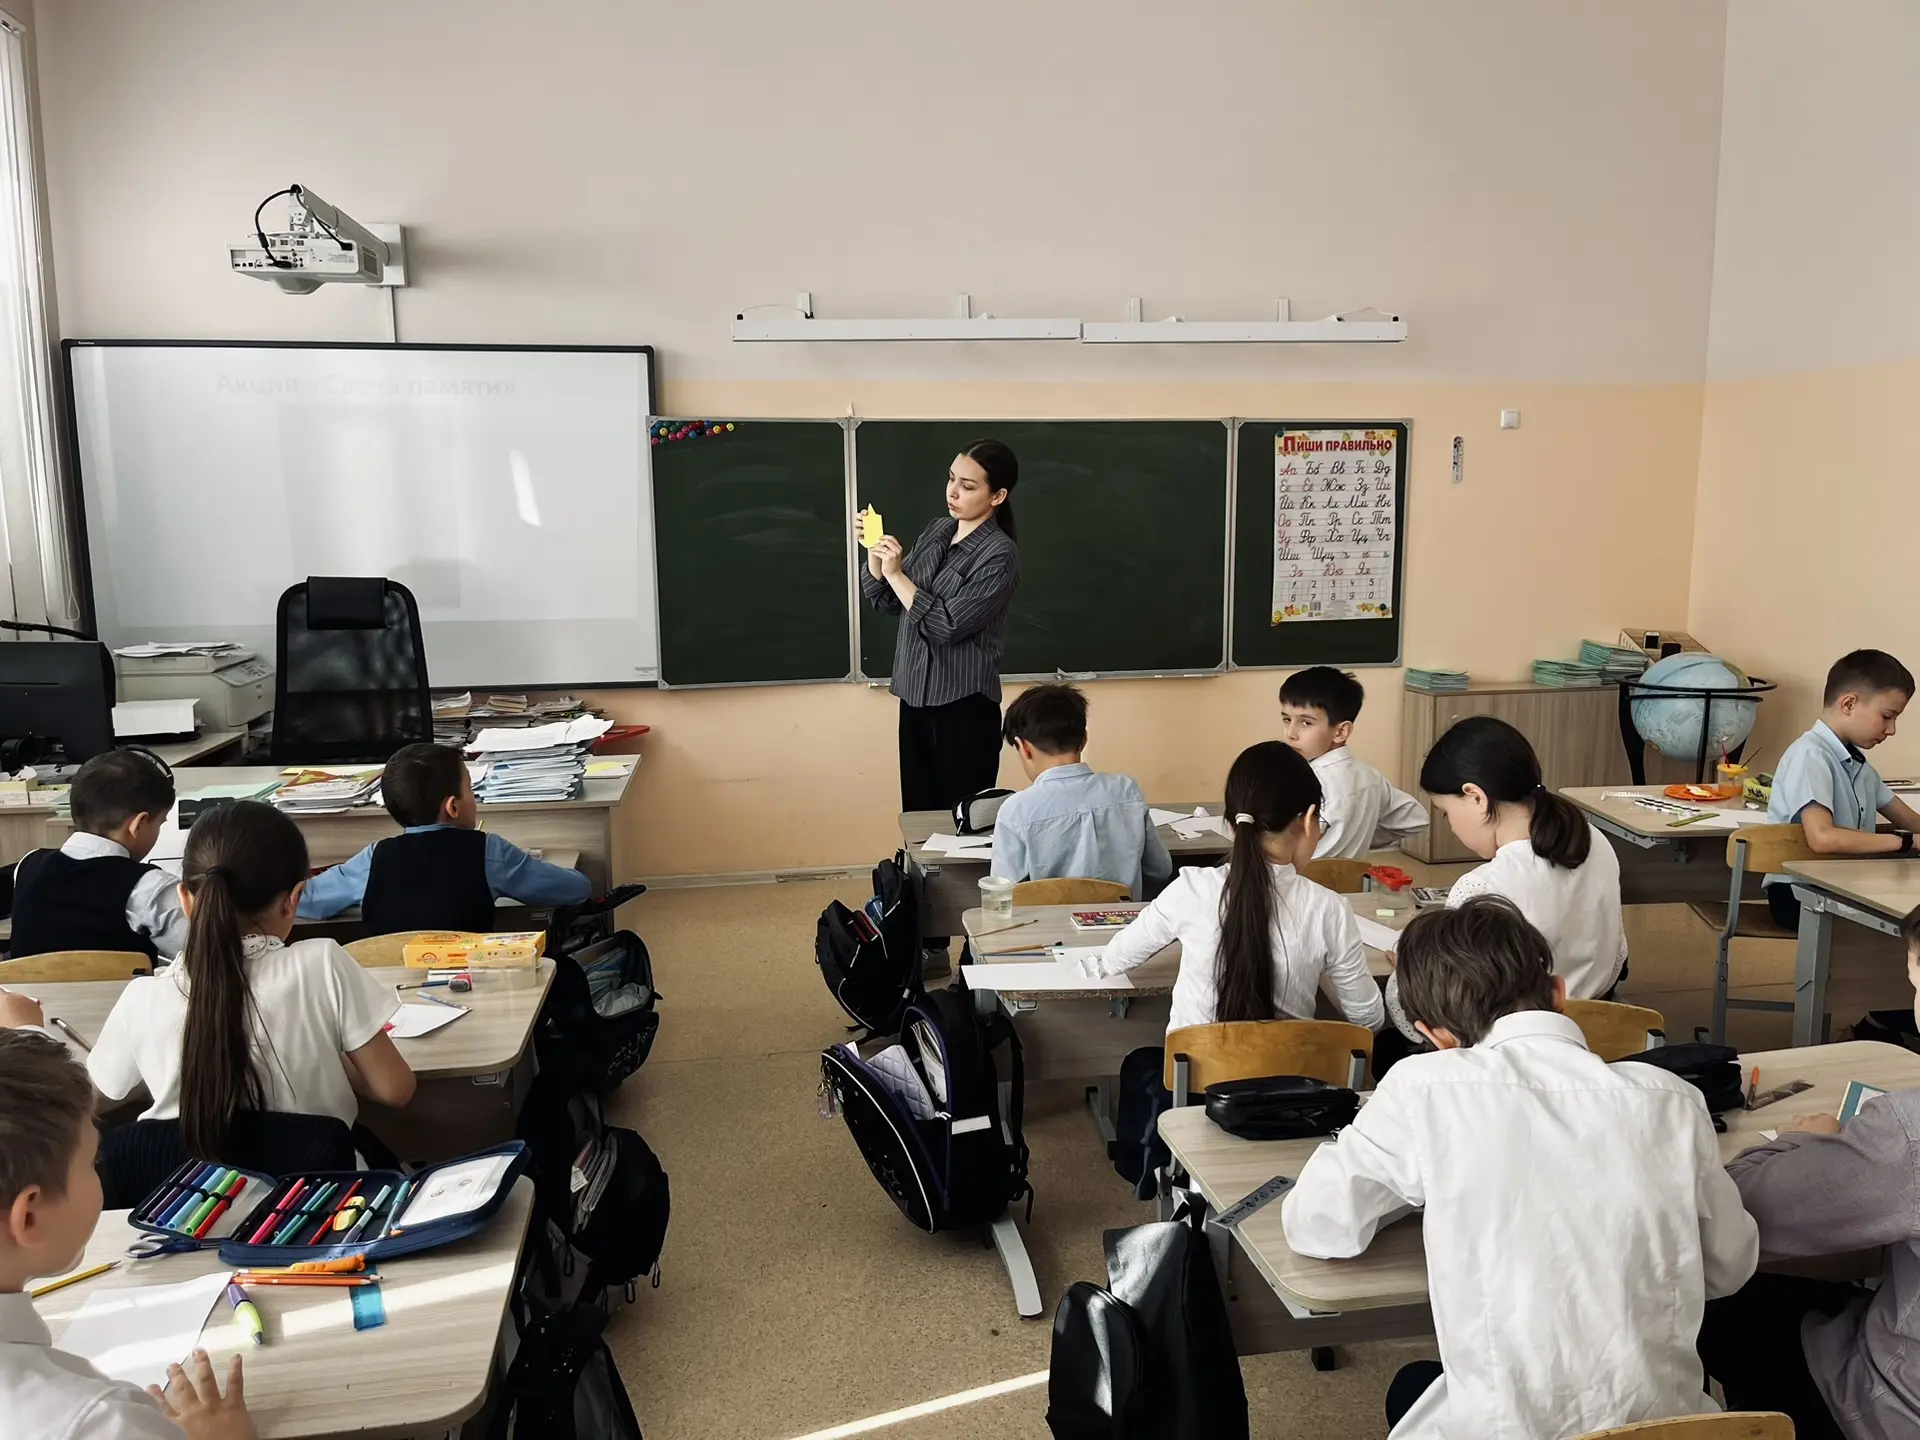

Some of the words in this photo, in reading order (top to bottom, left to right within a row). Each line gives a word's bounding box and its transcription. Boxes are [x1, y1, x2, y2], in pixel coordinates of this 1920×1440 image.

[216, 373, 299, 397] Акция
[409, 377, 516, 397] памяти»
[1283, 436, 1322, 452] ПИШИ
[1325, 440, 1392, 452] ПРАВИЛЬНО
